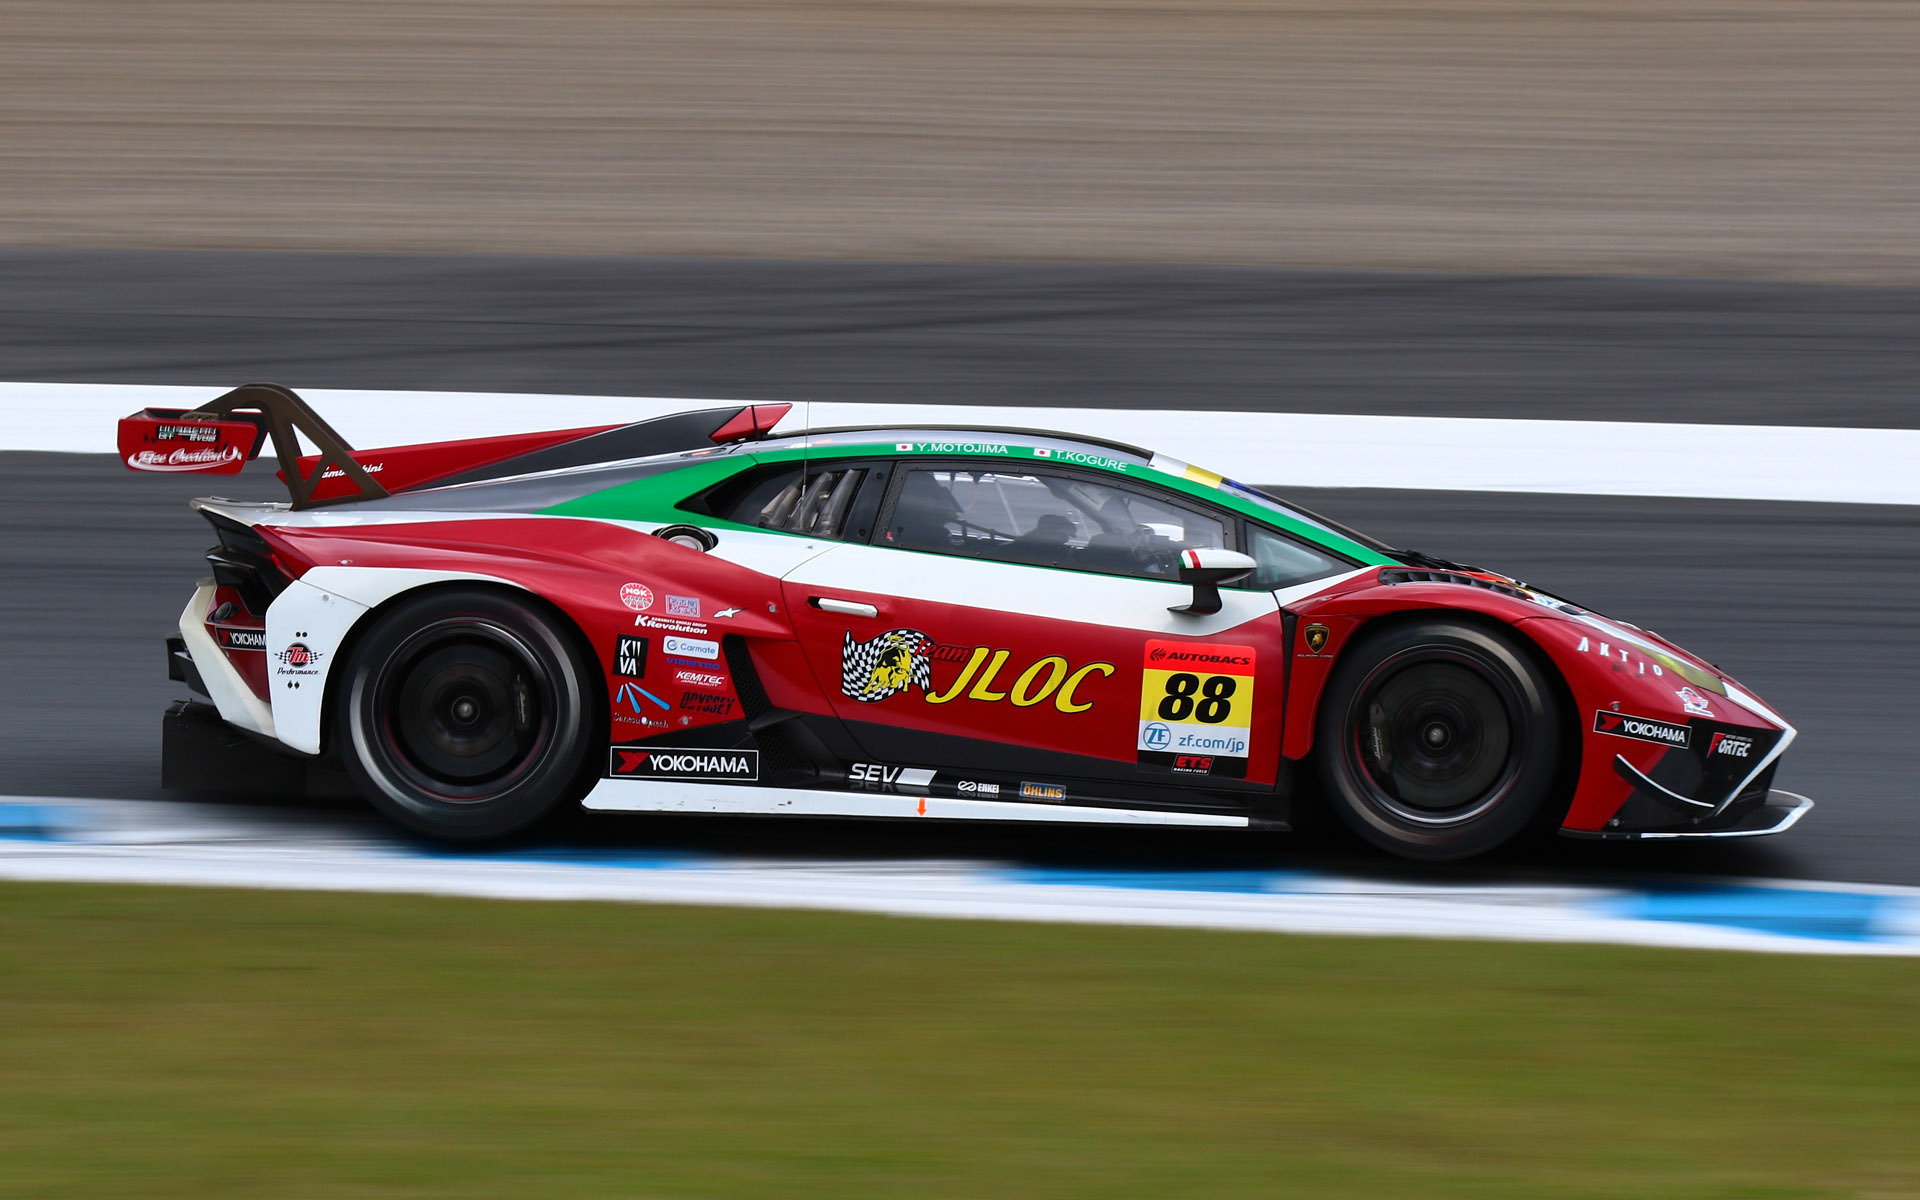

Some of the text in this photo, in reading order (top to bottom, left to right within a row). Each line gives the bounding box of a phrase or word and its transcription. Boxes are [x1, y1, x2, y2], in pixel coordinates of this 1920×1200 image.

[917, 443, 1008, 454] Y.MOTOJIMA
[1055, 450, 1127, 472] T.KOGURE
[625, 587, 648, 597] NGK
[680, 643, 716, 655] Carmate
[913, 640, 971, 662] Team
[1577, 636, 1663, 676] AKTIO
[1167, 652, 1251, 665] AUTOBACS
[277, 667, 319, 675] Performance
[676, 671, 725, 685] KEMITEC
[925, 646, 1116, 713] JLOC
[1158, 673, 1237, 724] 88
[1623, 720, 1685, 743] YOKOHAMA
[1146, 728, 1245, 753] ZF zf.com/jp
[649, 754, 750, 774] YOKOHAMA
[1176, 756, 1212, 769] ETS
[849, 763, 899, 783] SEV
[977, 783, 1000, 794] ENKEI
[1023, 784, 1063, 799] ÖHLINS
